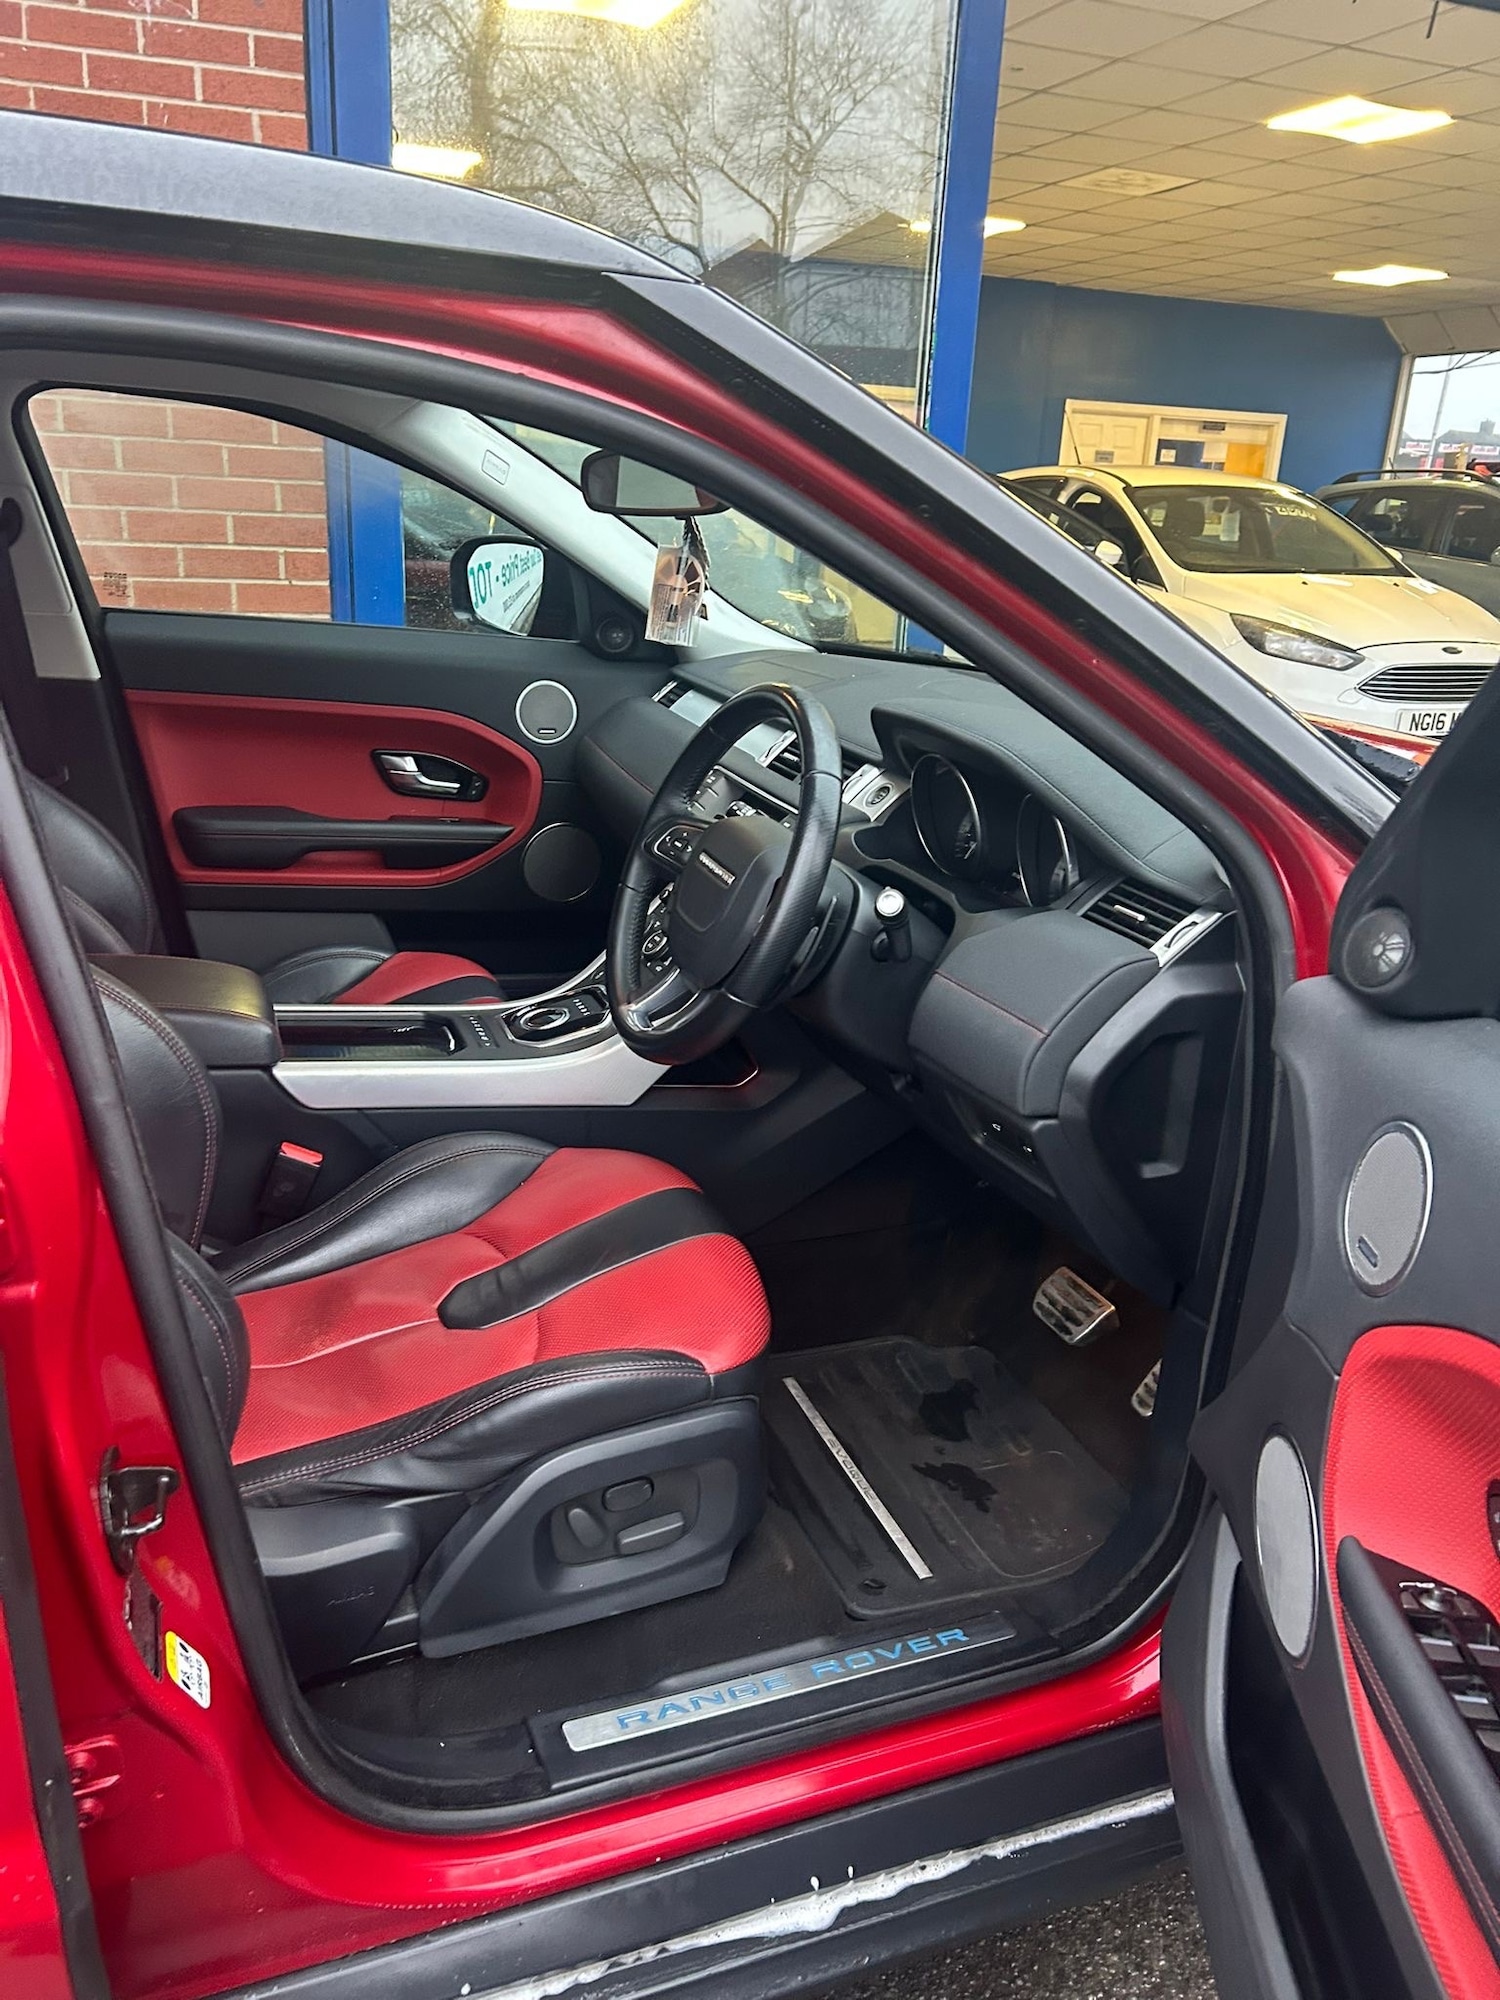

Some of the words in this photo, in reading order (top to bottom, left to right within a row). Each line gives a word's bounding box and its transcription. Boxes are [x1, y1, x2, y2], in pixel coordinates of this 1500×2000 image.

[1409, 712, 1447, 731] NG16
[827, 1437, 876, 1501] EVOQUE
[615, 1673, 792, 1730] RANGE
[811, 1627, 970, 1680] ROVER
